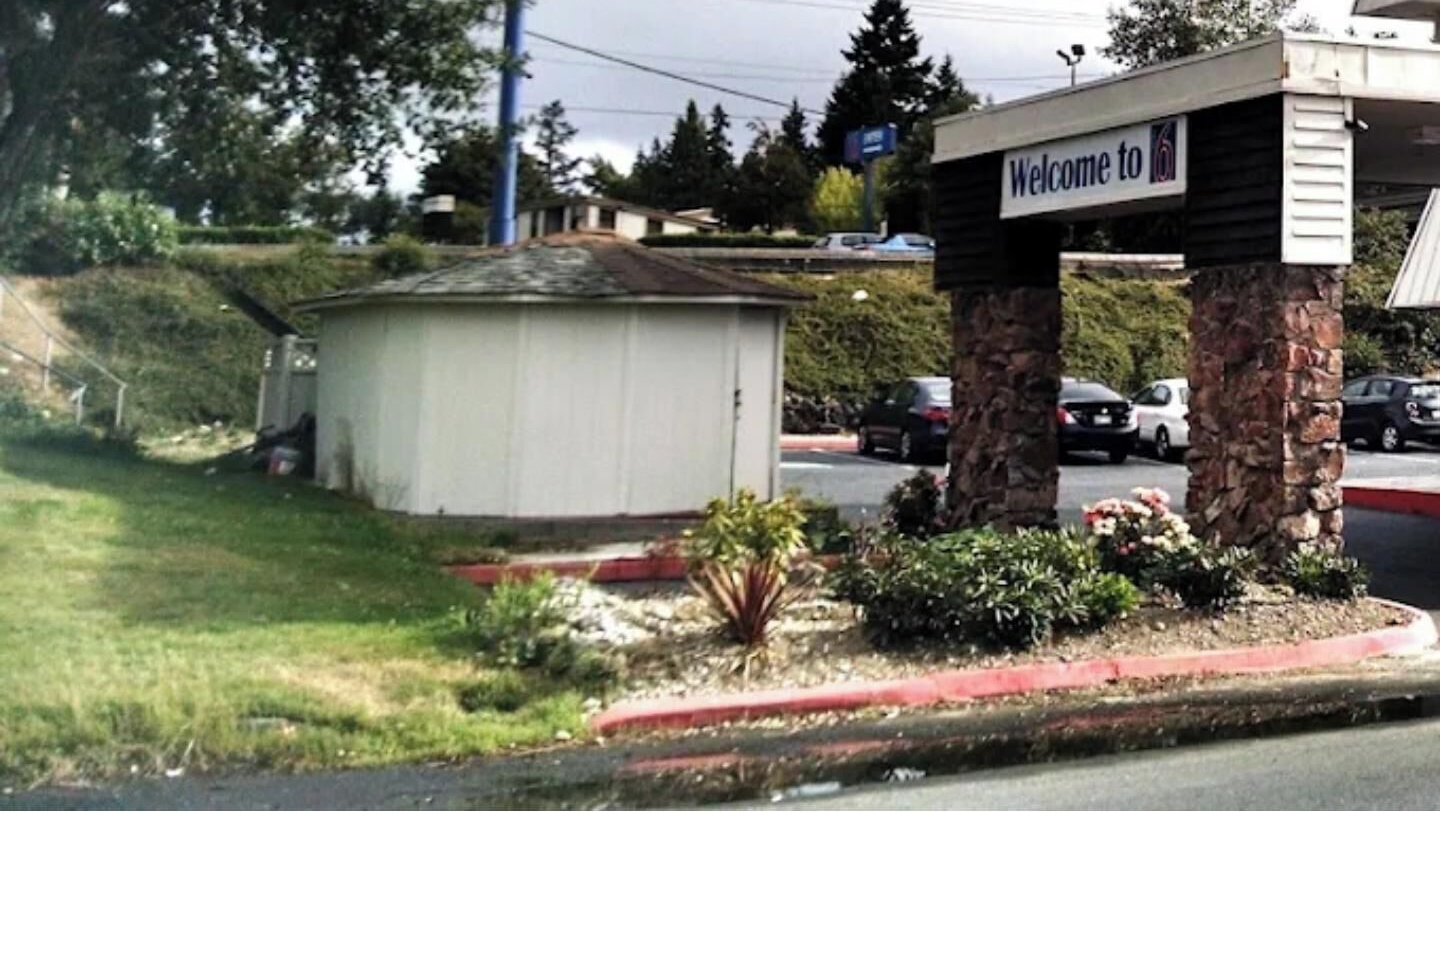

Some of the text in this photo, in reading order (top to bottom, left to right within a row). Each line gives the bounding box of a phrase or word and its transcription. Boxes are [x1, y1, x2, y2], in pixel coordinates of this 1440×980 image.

[1010, 121, 1174, 198] Welcome to 6
